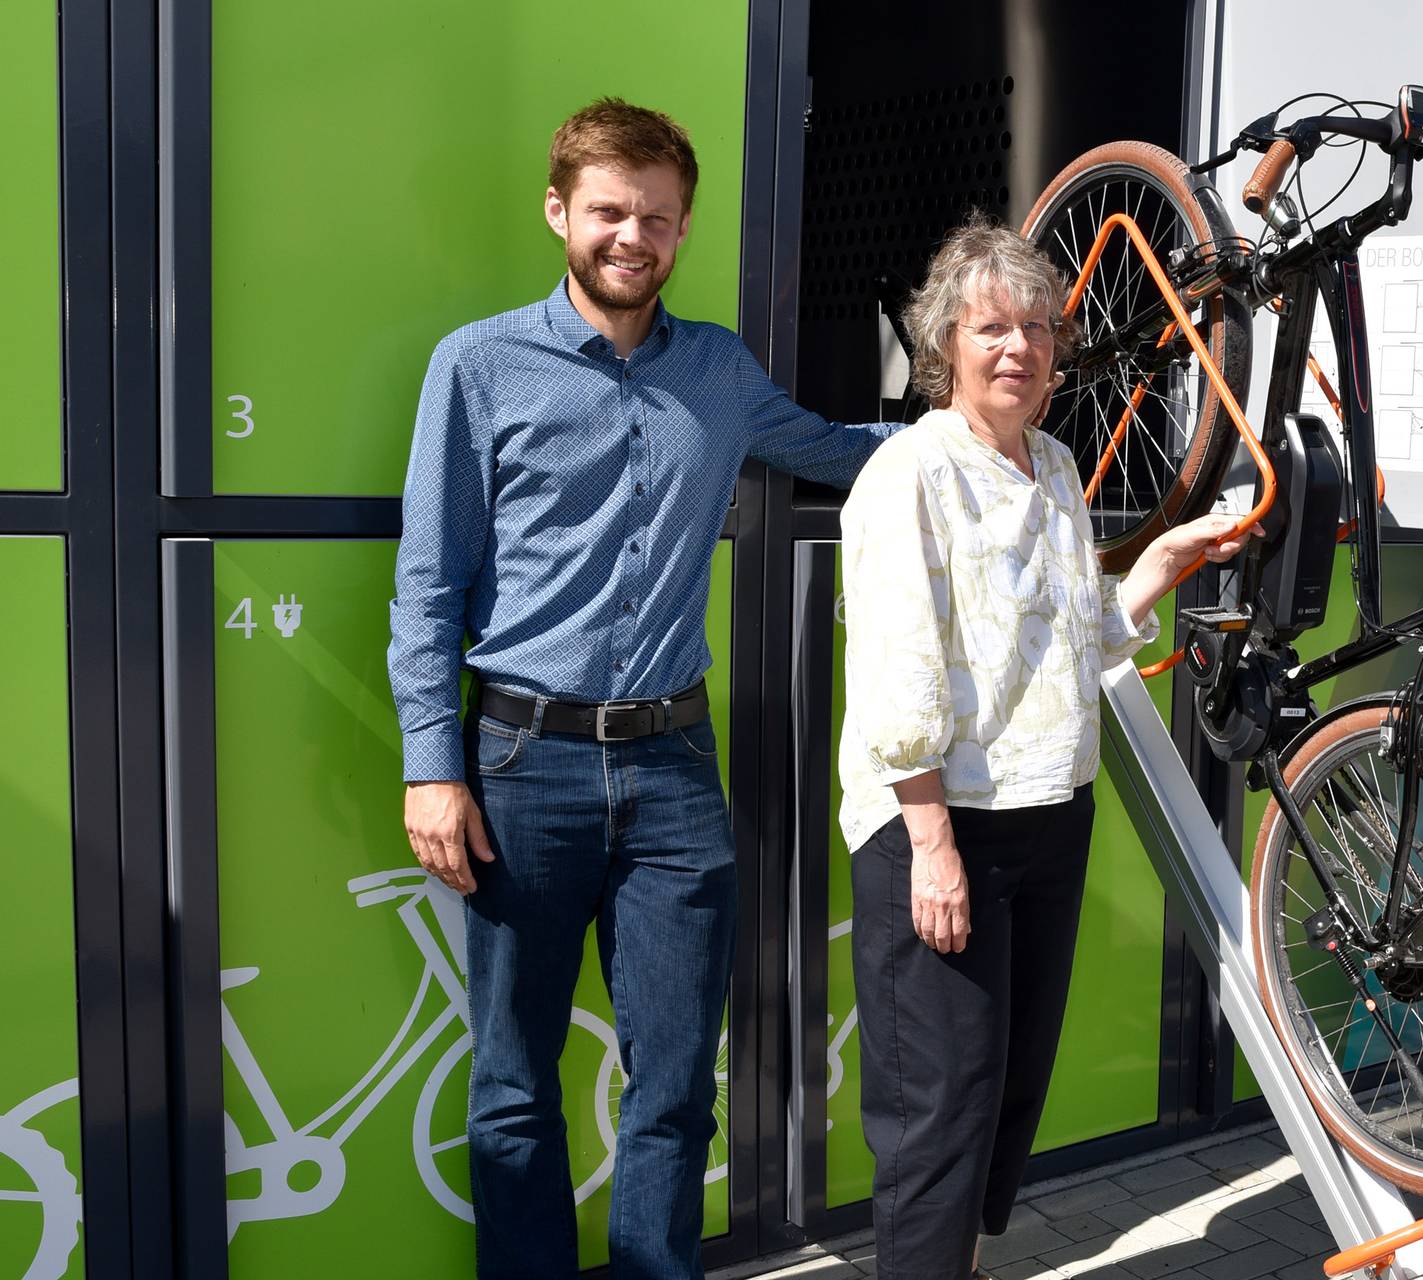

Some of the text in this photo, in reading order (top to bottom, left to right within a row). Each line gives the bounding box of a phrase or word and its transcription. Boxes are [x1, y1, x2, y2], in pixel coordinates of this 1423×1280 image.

[1365, 248, 1397, 268] DER
[225, 394, 255, 438] 3
[224, 597, 257, 639] 4
